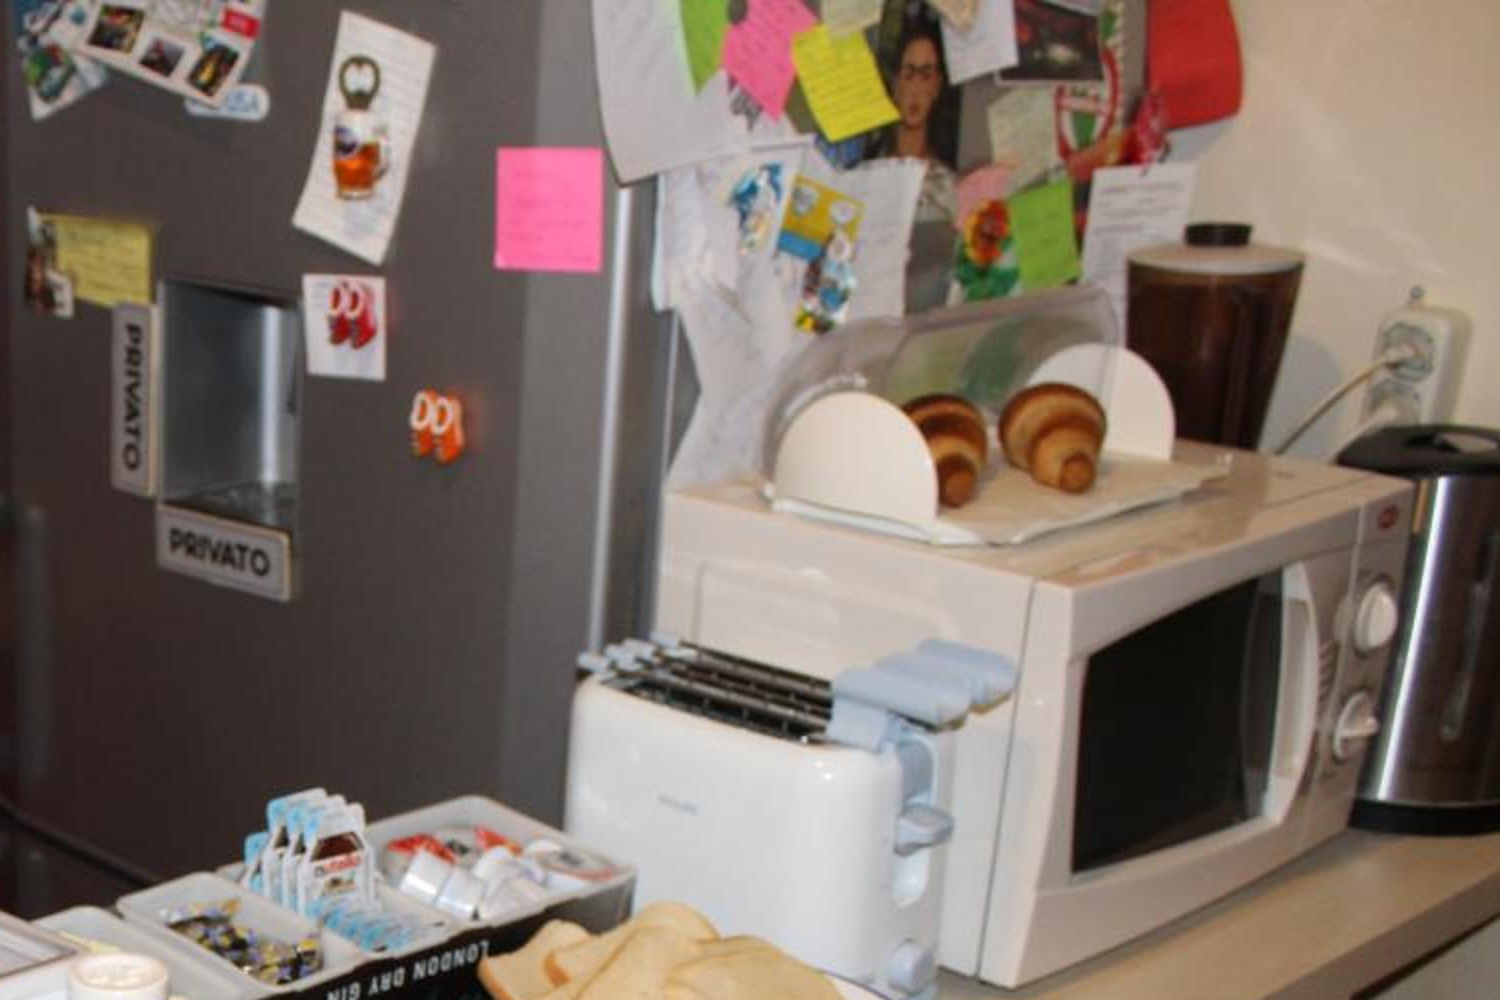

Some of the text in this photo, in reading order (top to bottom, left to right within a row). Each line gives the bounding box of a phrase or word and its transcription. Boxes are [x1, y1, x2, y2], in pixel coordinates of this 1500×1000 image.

[122, 322, 143, 471] PRIVATO
[168, 527, 270, 577] PRIVATO
[368, 966, 406, 996] DRY
[412, 940, 491, 981] LONDON
